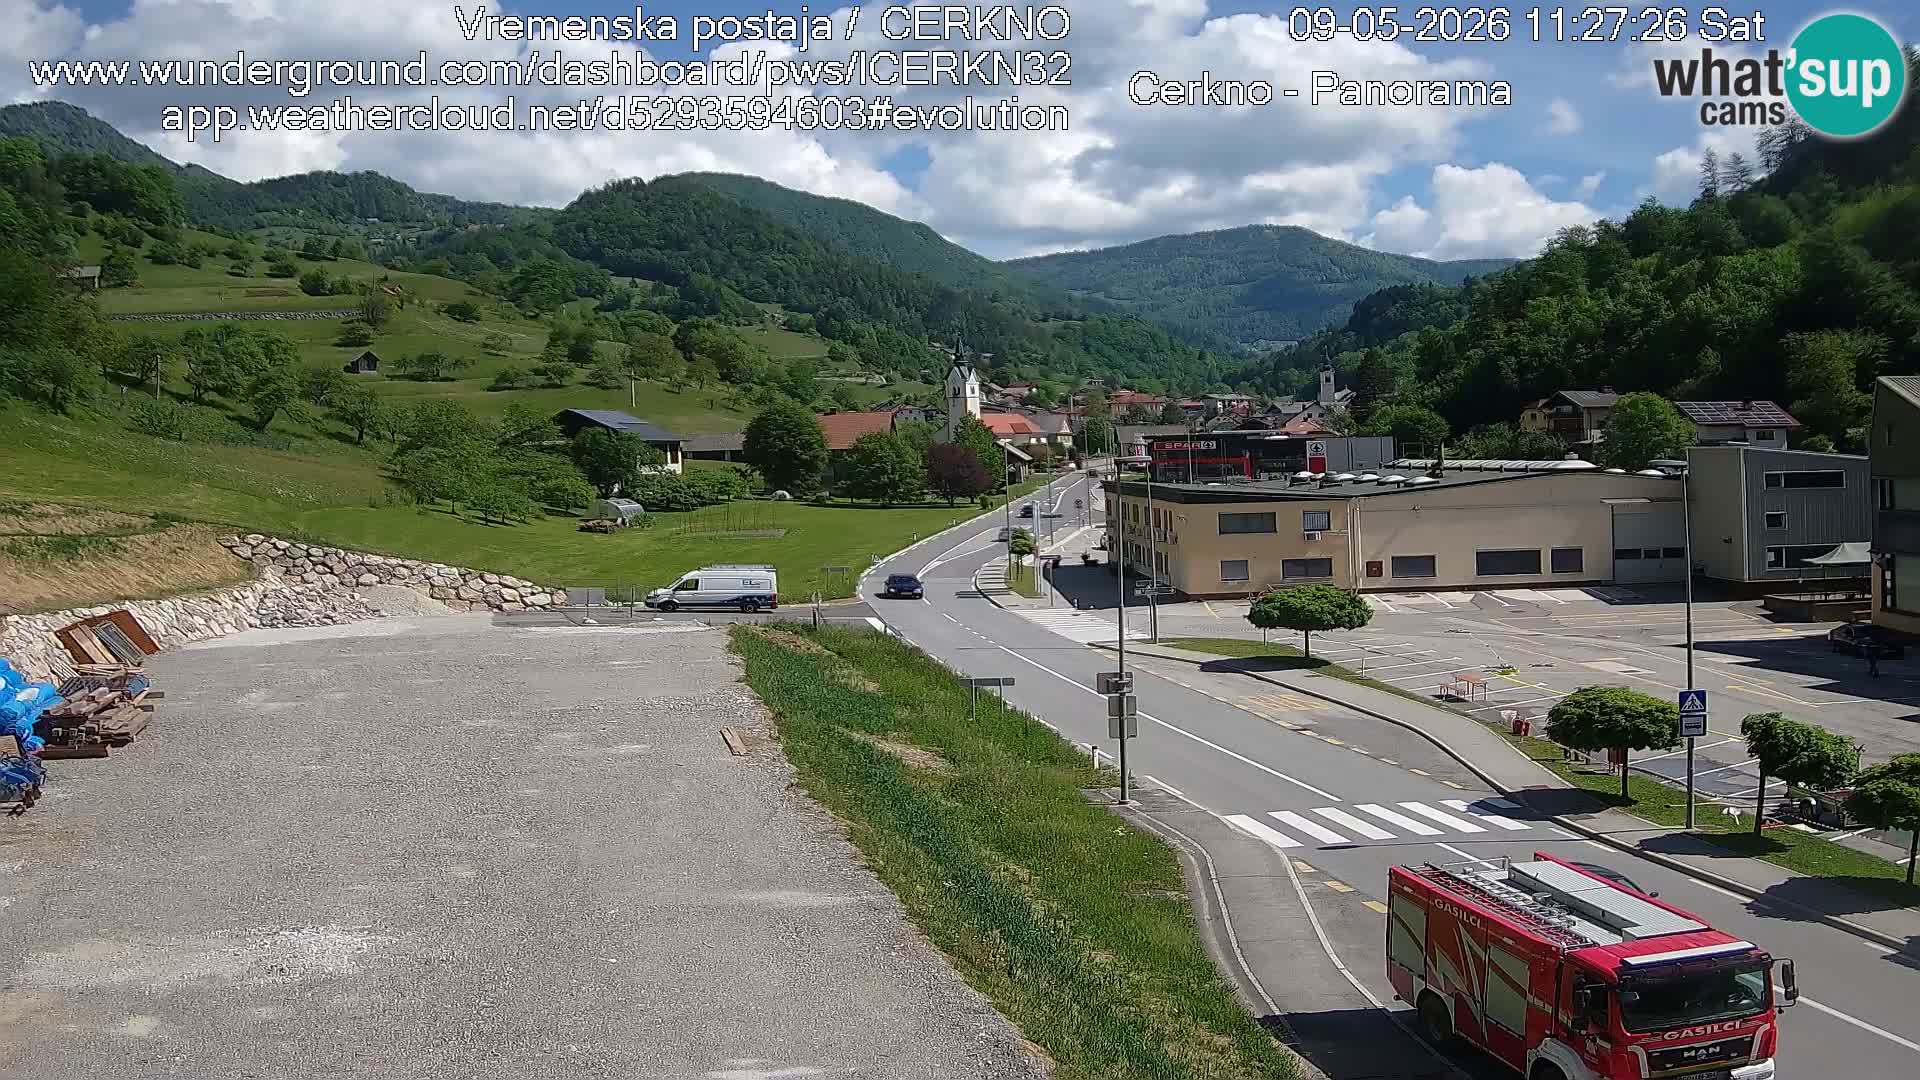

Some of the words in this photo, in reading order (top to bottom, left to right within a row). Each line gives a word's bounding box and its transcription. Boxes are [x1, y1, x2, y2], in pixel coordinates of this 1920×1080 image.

[1164, 442, 1201, 450] SPAR
[1434, 898, 1481, 929] GASILCI
[1663, 1019, 1743, 1042] GASILCI
[1683, 1045, 1721, 1058] MAN
